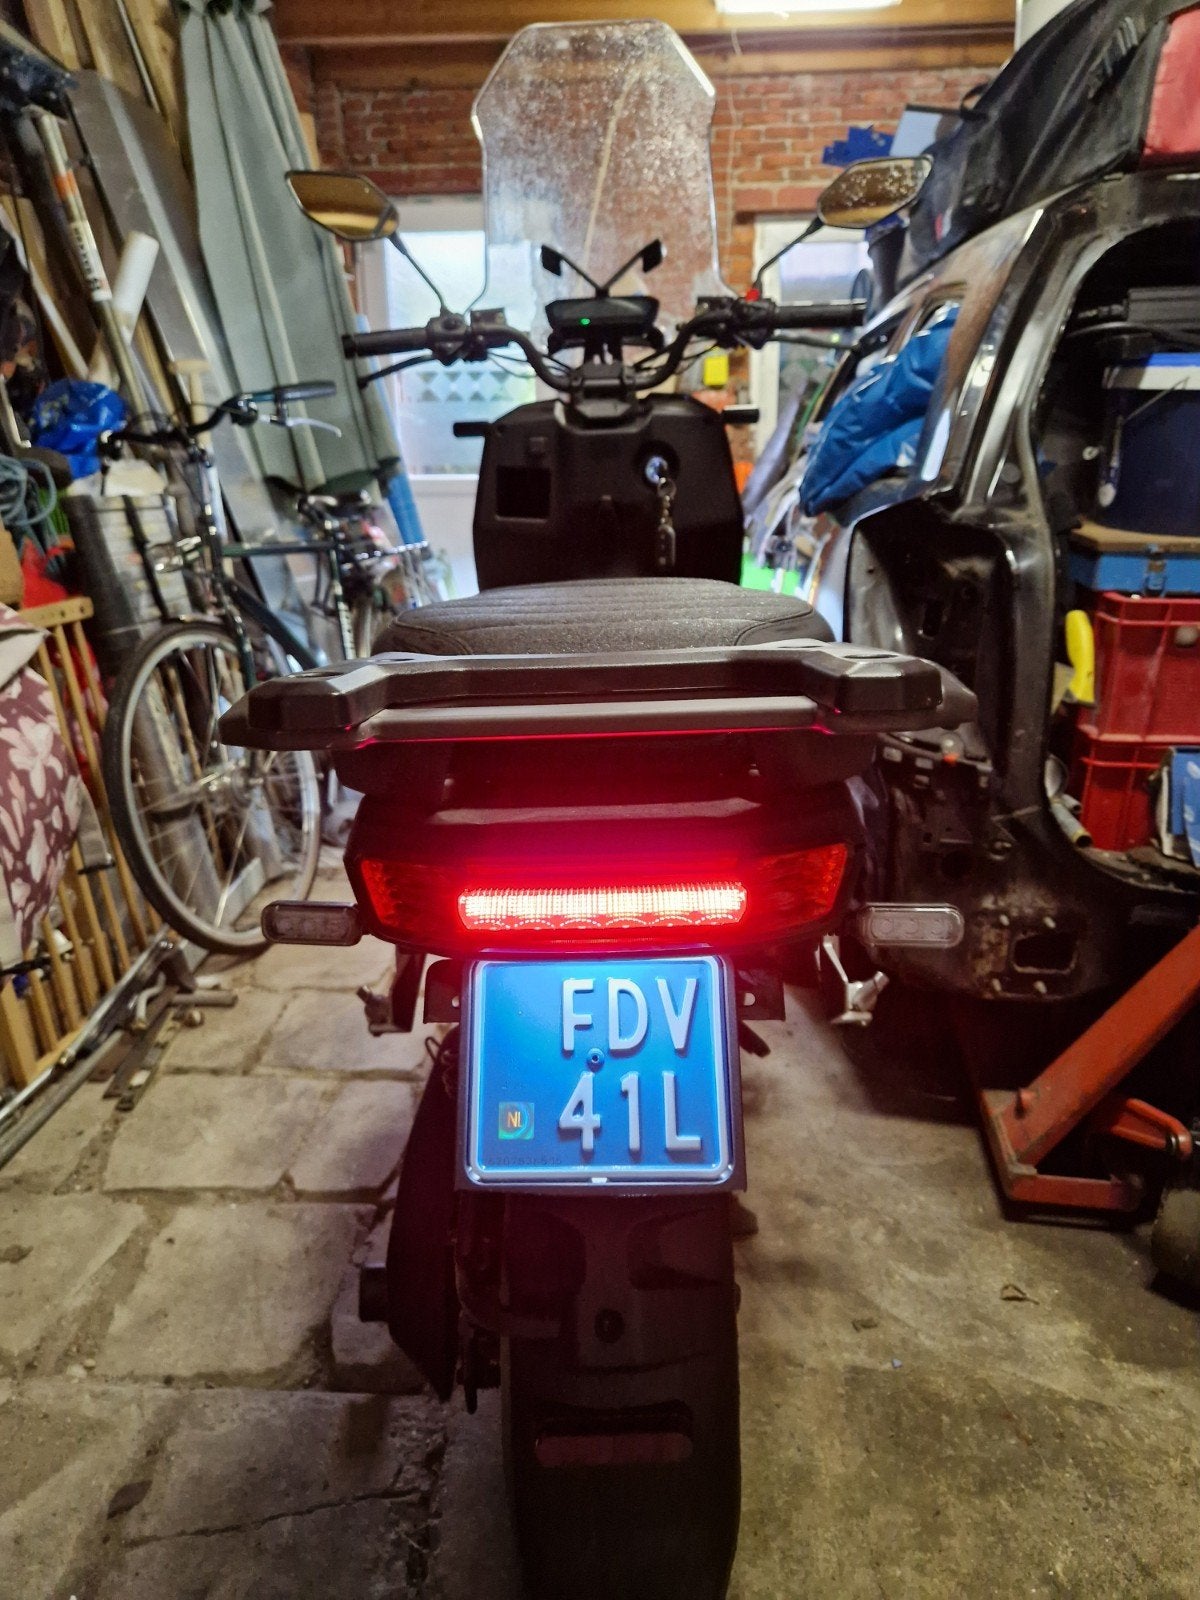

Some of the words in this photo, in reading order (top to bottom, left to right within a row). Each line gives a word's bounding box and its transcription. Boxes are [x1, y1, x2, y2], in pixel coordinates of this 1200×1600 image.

[562, 977, 697, 1051] FDV
[507, 1111, 522, 1128] NL
[559, 1071, 701, 1151] 41L
